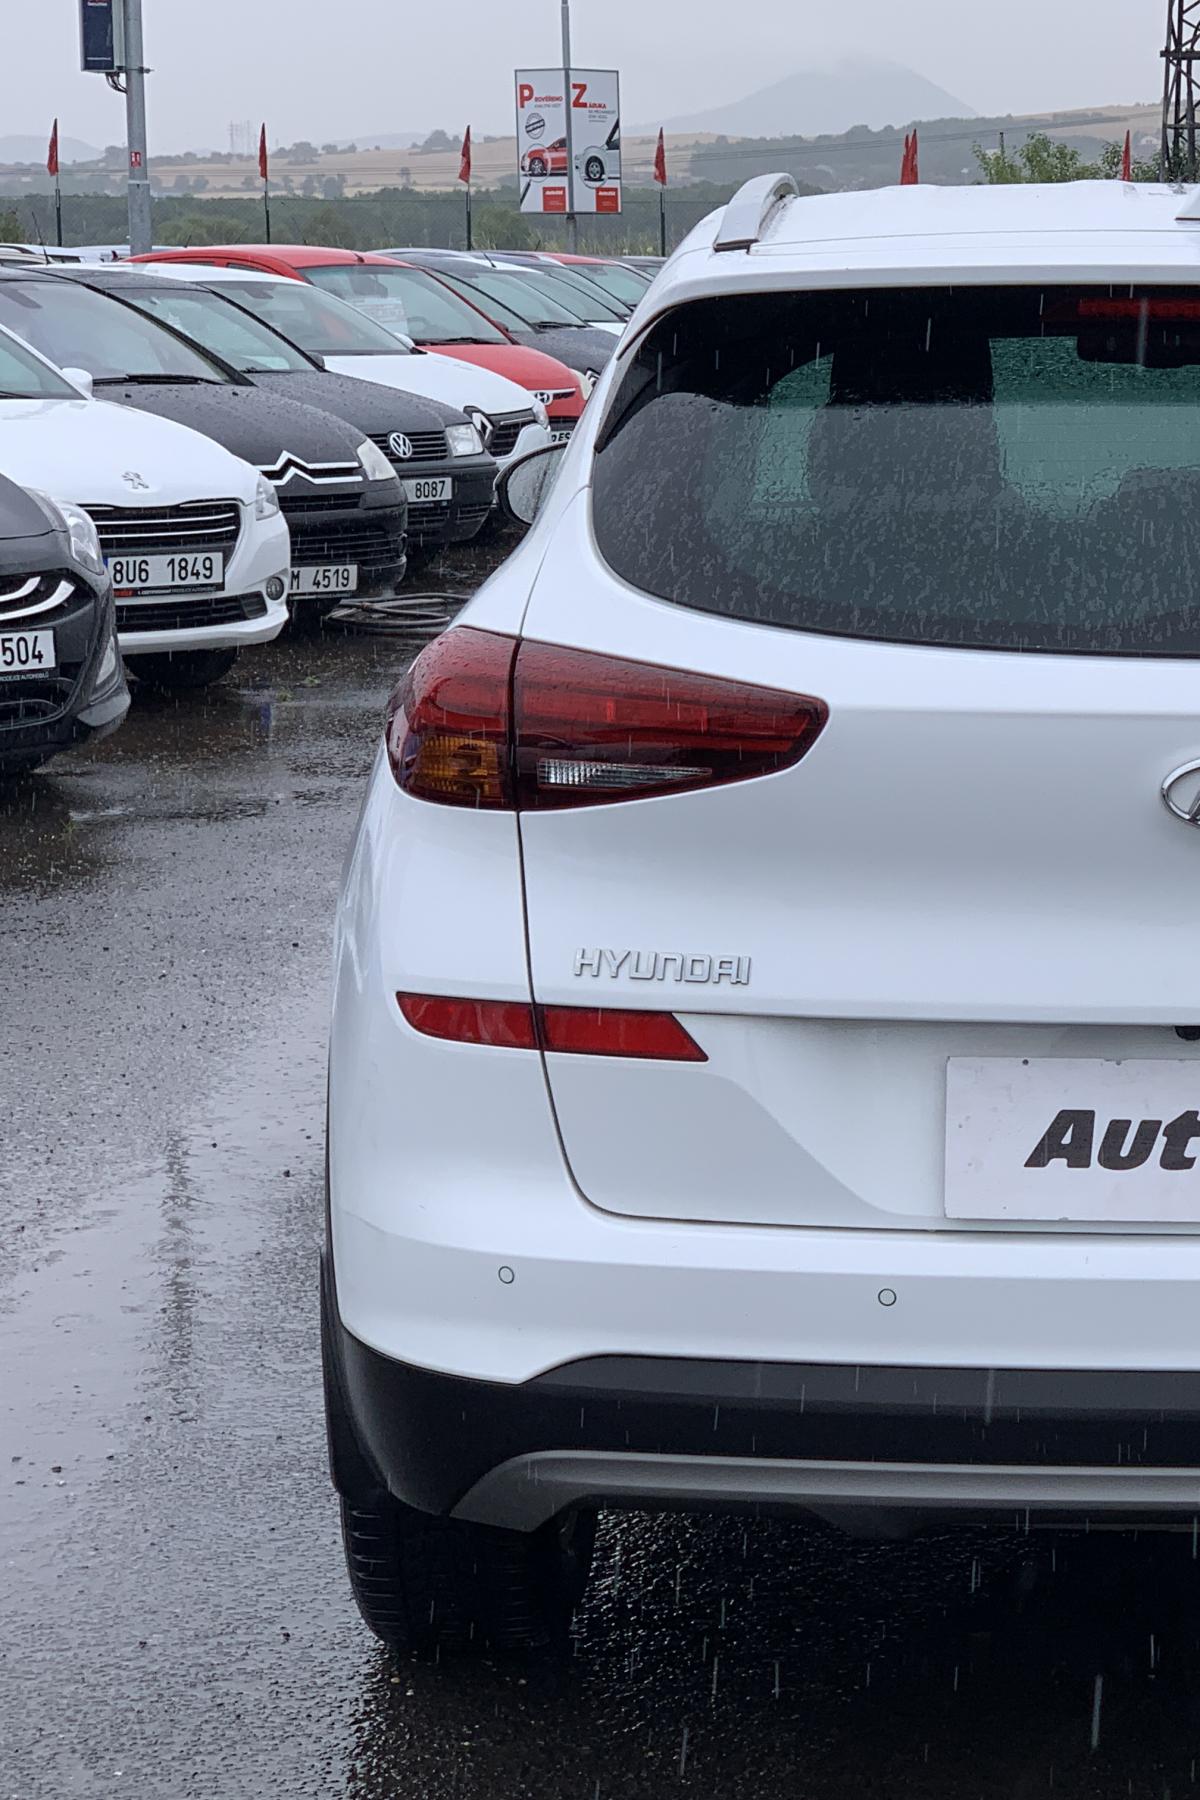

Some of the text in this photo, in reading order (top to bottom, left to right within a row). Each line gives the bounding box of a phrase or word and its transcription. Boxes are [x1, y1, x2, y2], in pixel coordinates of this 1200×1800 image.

[414, 480, 446, 499] 8087
[113, 556, 213, 584] 8U6 1849
[290, 567, 350, 590] M 4519
[1, 635, 44, 666] 504
[574, 948, 751, 985] HYUNDAI
